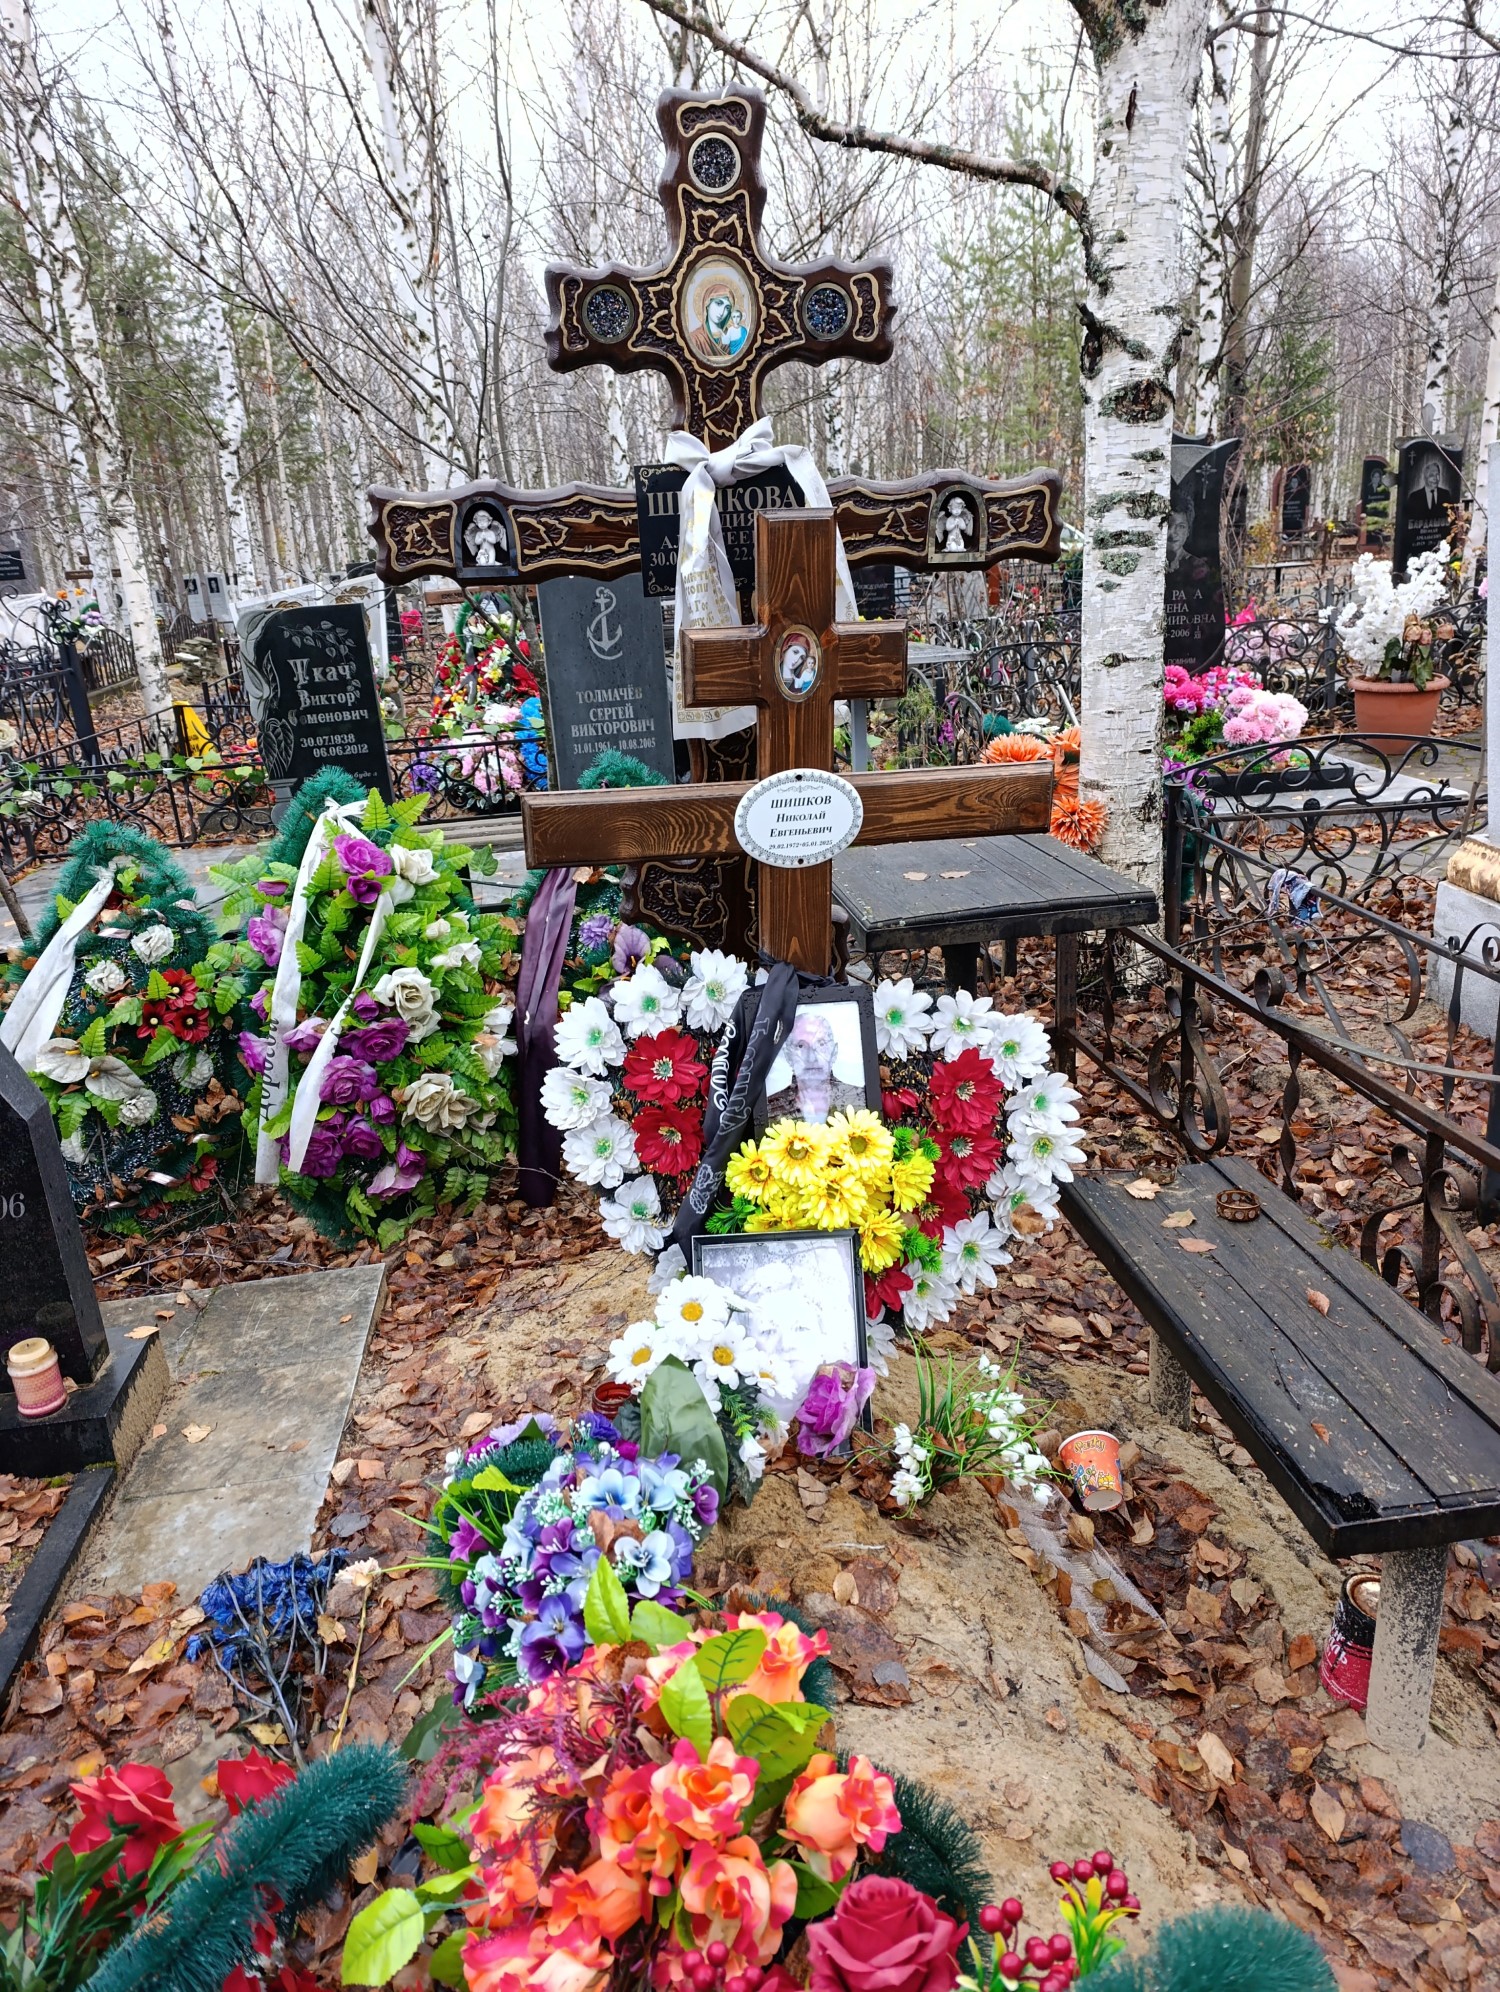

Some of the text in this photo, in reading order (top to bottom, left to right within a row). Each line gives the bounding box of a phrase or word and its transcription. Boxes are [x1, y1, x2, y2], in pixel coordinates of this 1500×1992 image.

[648, 485, 799, 517] ШКОВА
[721, 512, 755, 528] ДИЯ
[1164, 603, 1189, 614] ЕНА
[296, 689, 356, 711] Виктор
[576, 684, 643, 704] ТОЛМАЧЁВ
[589, 703, 634, 721] СЕРГЕЙ
[571, 718, 655, 737] ВИКТОРОВИЧ
[300, 733, 356, 749] 30.07.1938
[619, 738, 656, 751] 10.08.2005
[313, 743, 369, 758] 06.06.2012
[770, 795, 832, 809] ШИШКОВ
